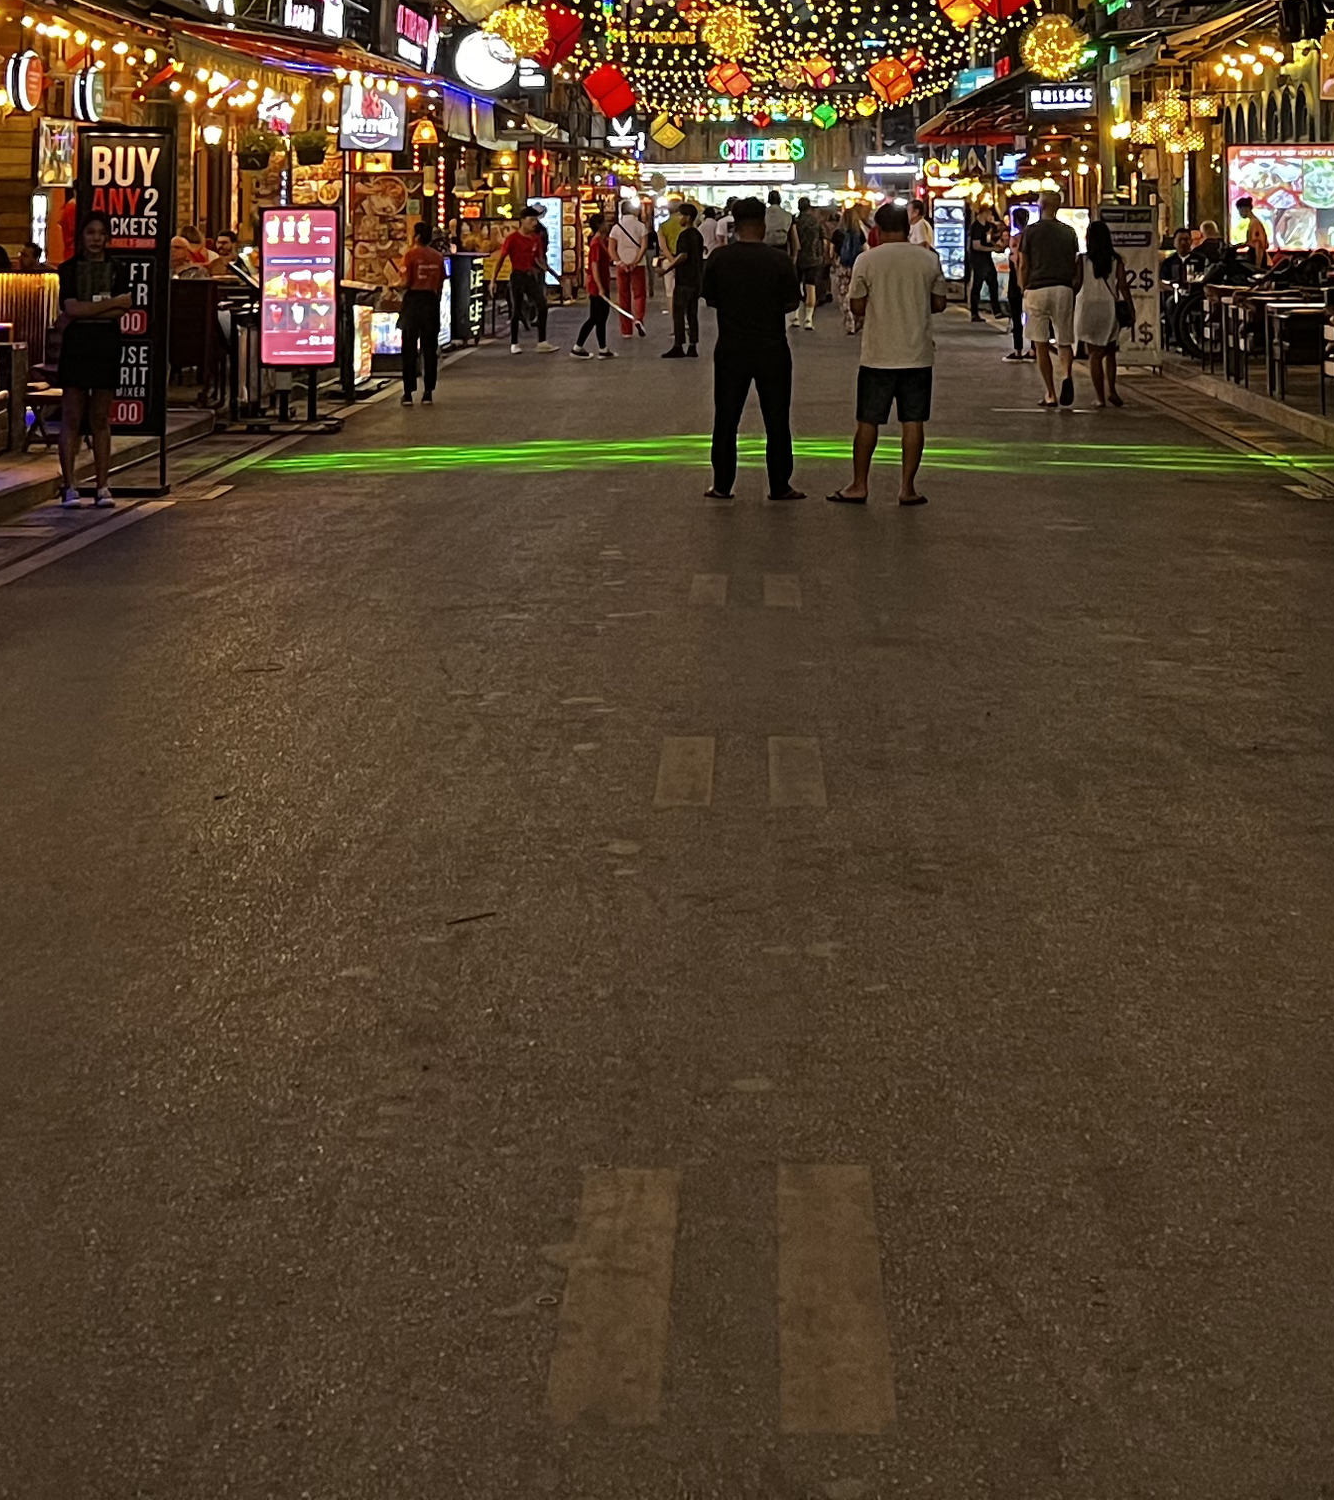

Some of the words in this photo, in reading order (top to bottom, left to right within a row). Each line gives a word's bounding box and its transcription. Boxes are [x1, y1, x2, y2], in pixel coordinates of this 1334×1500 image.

[91, 145, 161, 187] BUY
[91, 187, 142, 216] ANY
[143, 187, 160, 217] 2
[109, 217, 158, 236] CKETS
